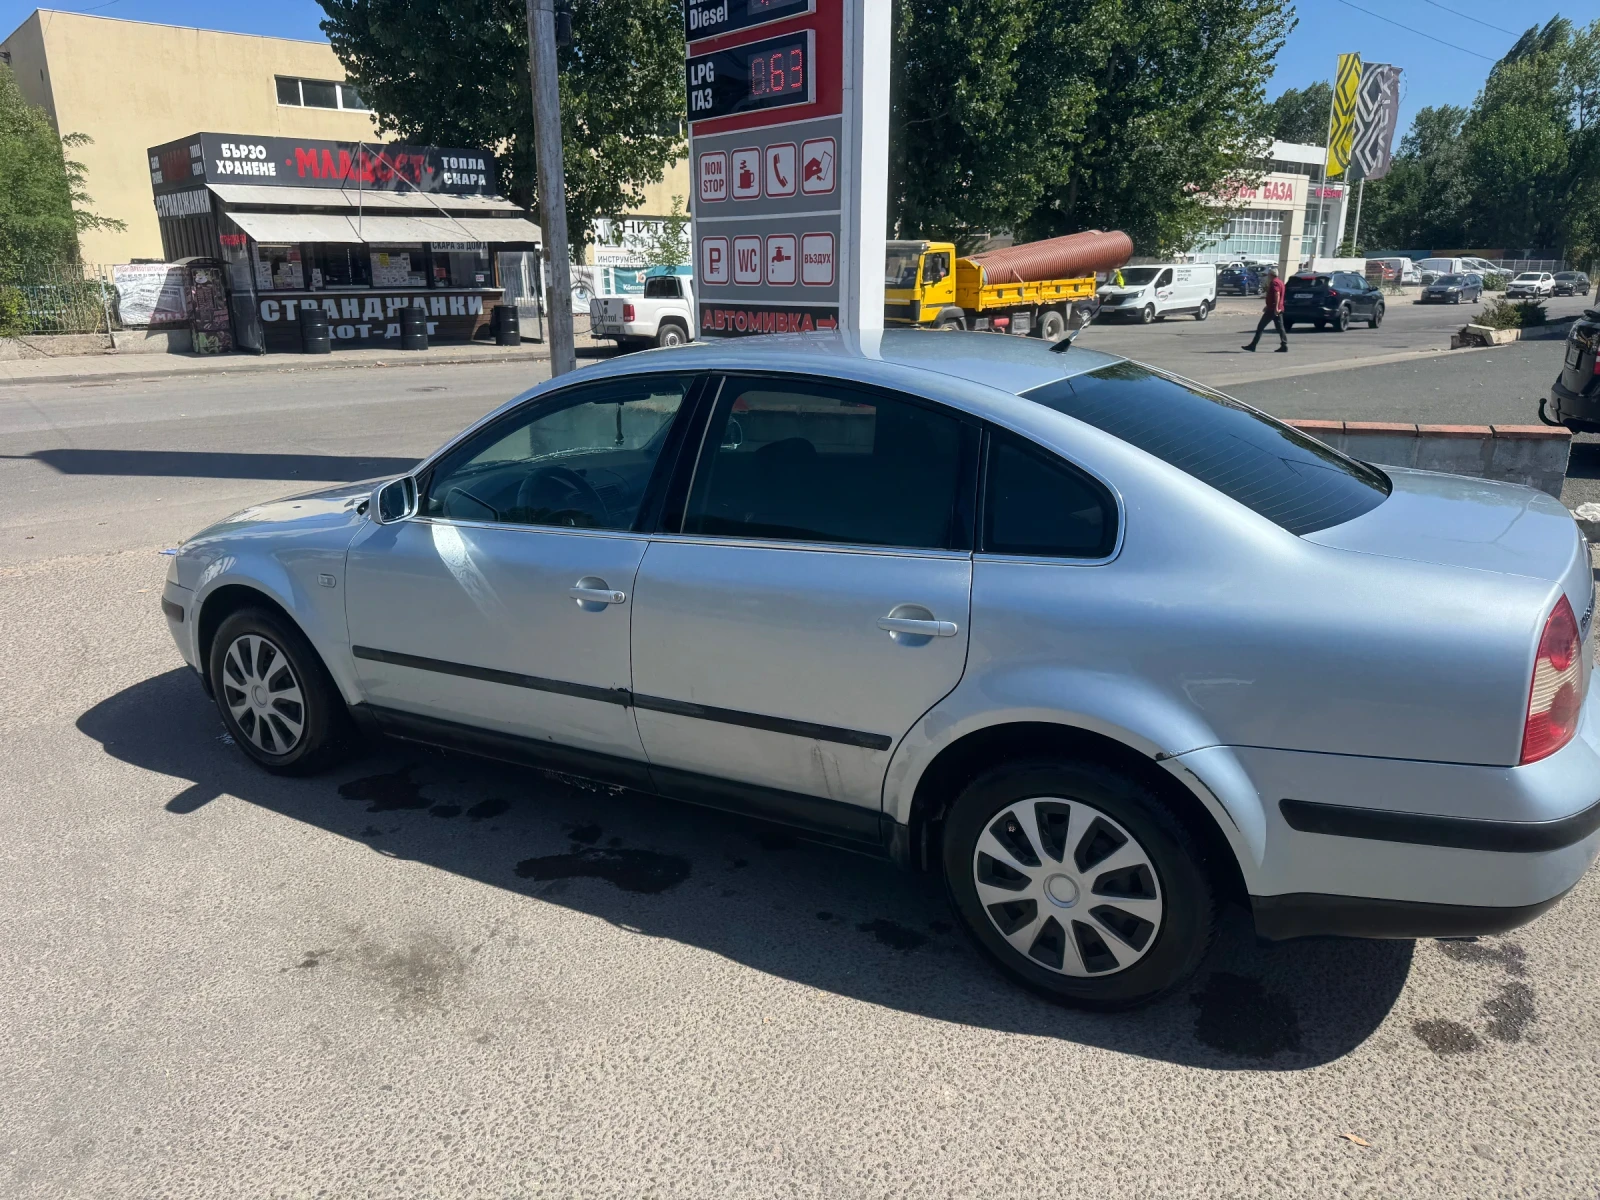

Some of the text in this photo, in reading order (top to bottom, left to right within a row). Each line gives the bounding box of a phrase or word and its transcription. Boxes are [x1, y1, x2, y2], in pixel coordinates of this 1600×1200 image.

[689, 0, 729, 30] Diesel
[690, 61, 715, 86] LPG
[751, 48, 803, 95] 0.63
[691, 88, 713, 111] ГАЗ
[221, 143, 267, 159] БЪРЗО
[216, 159, 277, 176] ХРАНЕНЕ
[295, 147, 425, 183] МЛАДОСТ
[441, 156, 486, 171] ТОПЛА
[704, 160, 722, 176] NON
[443, 172, 487, 186] СКАРА
[703, 178, 725, 194] STOP
[1263, 181, 1293, 201] БАЗА
[156, 188, 212, 218] СТРАНДЖАНКИ
[432, 242, 455, 251] СКАРА
[738, 248, 757, 273] WC
[804, 253, 831, 266] ВЪЗДУХ
[702, 309, 815, 334] АВТОМИВКА
